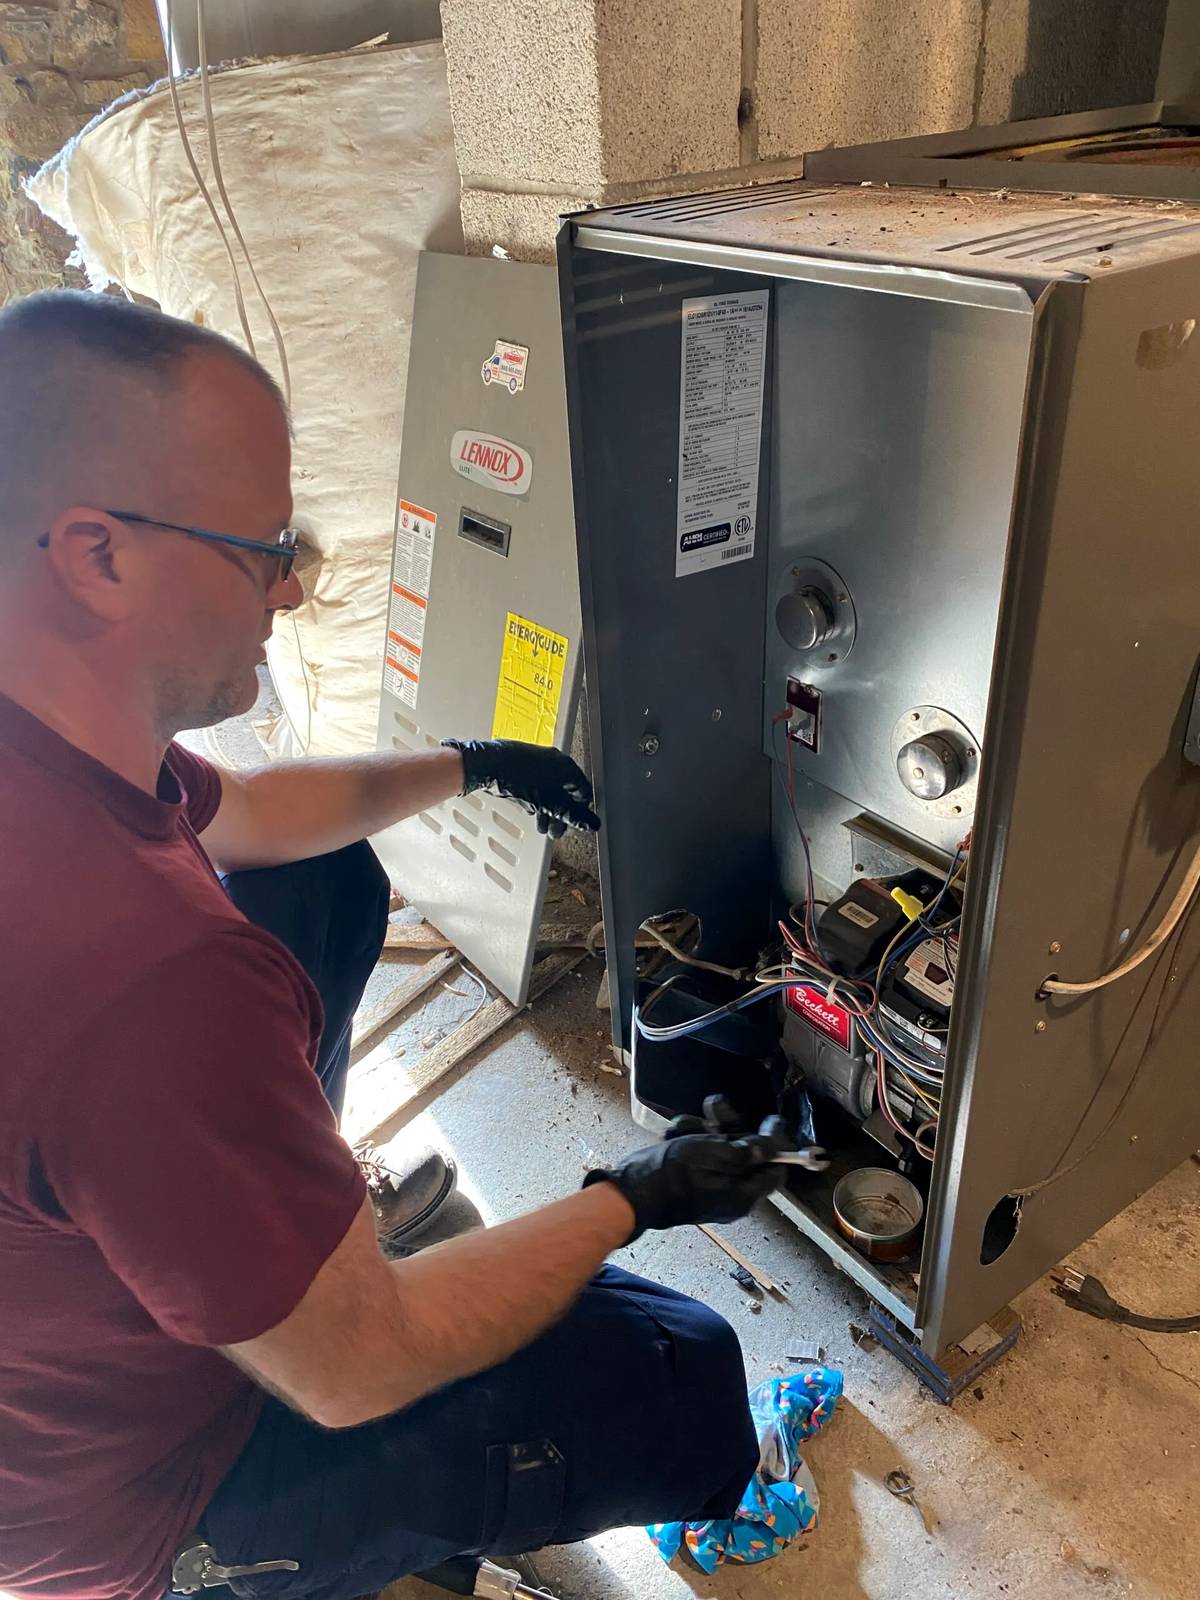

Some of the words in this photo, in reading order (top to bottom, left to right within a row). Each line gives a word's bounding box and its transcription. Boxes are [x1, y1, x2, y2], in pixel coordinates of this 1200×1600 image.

[460, 440, 512, 475] LENNOX
[509, 620, 565, 657] ENERGYGUDE
[795, 987, 839, 1026] Beckett
